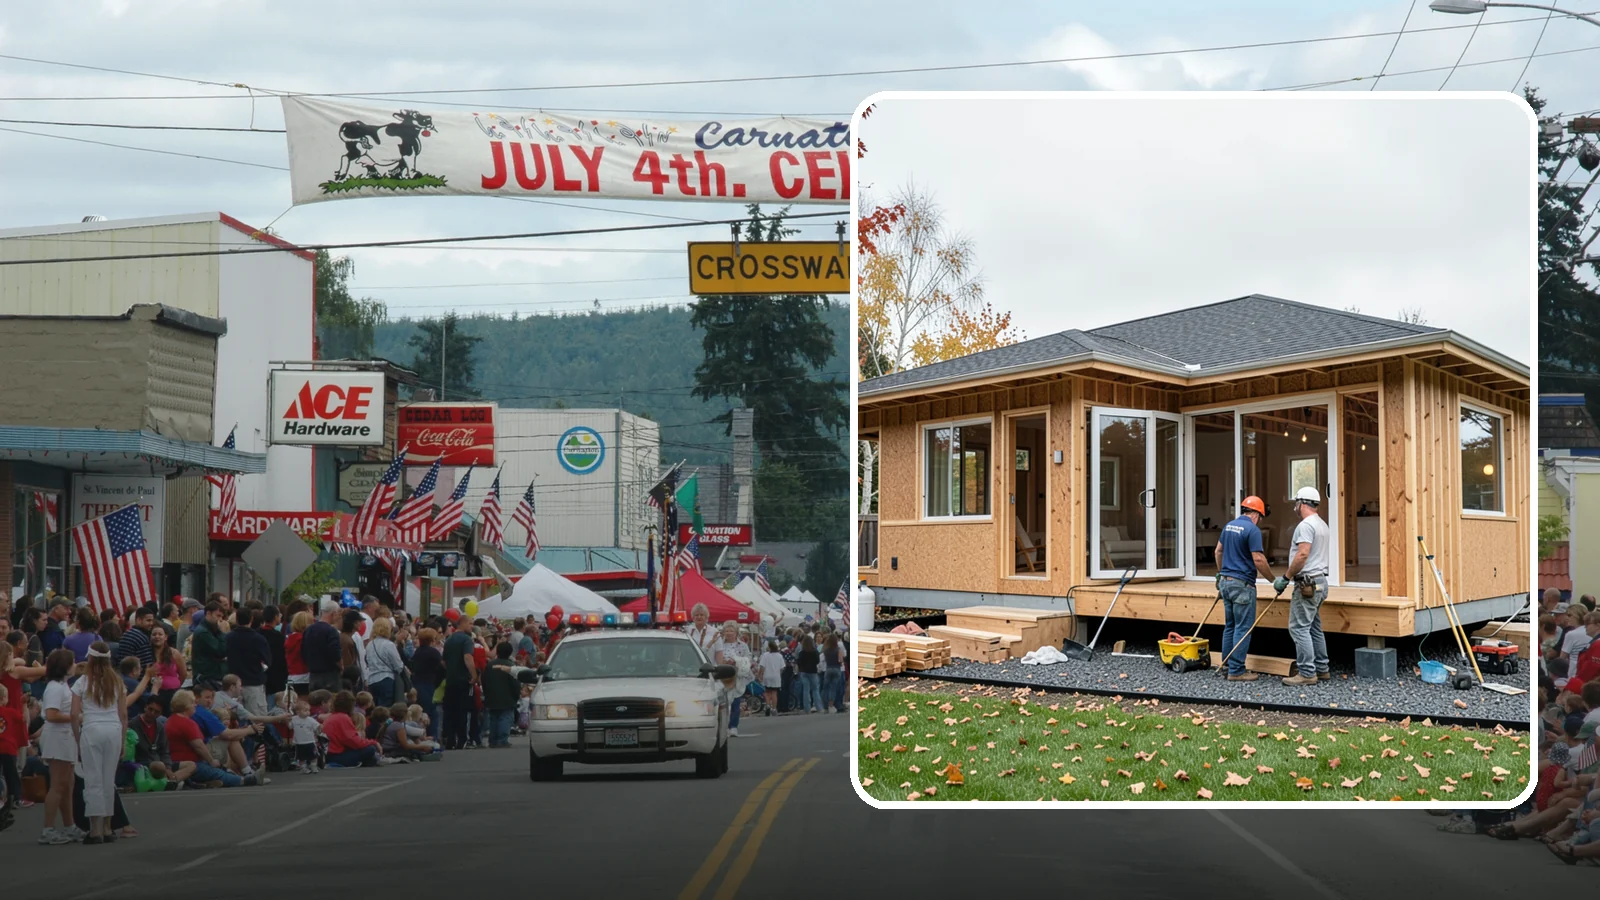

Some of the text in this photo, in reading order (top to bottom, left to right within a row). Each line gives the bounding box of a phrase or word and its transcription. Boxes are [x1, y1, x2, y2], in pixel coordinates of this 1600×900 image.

[481, 141, 605, 192] JULY
[632, 150, 746, 198] 4th.
[697, 254, 850, 280] CROSSWA
[283, 380, 373, 420] ACE
[406, 409, 485, 422] CEDAR LOG
[283, 421, 371, 437] Hardware
[416, 428, 477, 447] Coca-Cola
[353, 467, 385, 481] Simpl
[96, 485, 125, 495] Vincent
[126, 486, 136, 495] de
[137, 486, 155, 495] Paul
[81, 503, 154, 522] THT
[213, 516, 331, 535] HARDARE
[688, 526, 741, 535] CRNATION
[699, 535, 730, 543] GLASS
